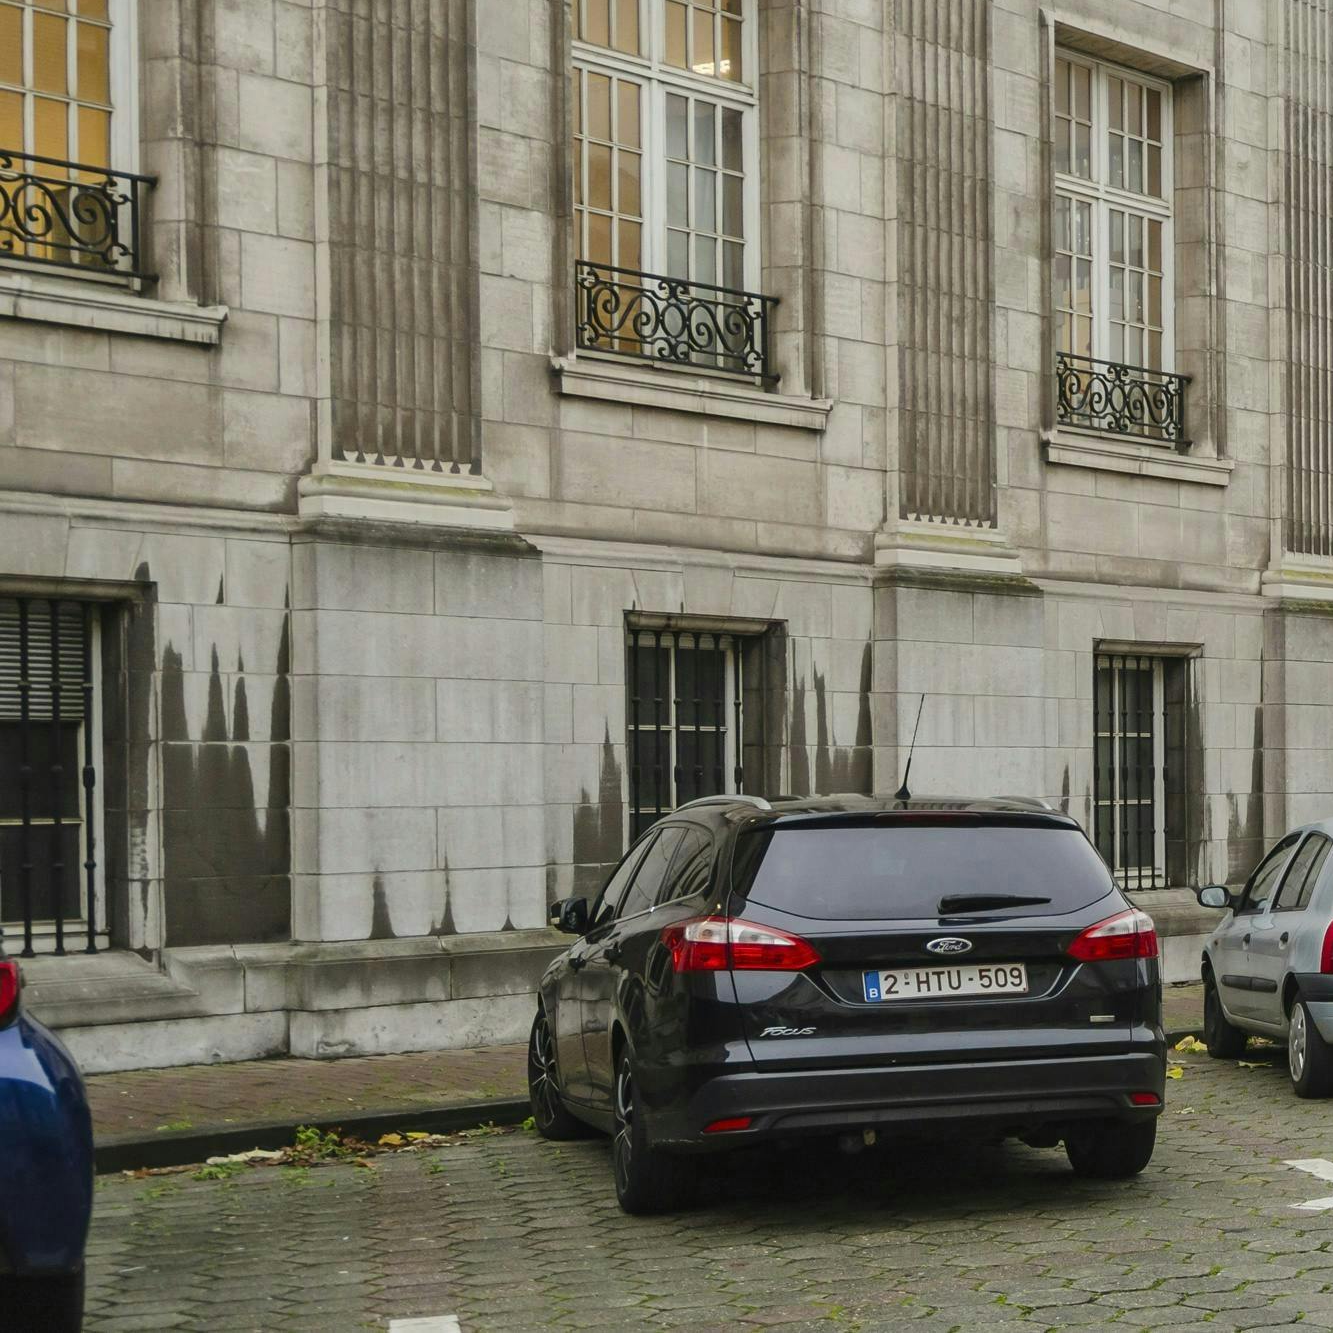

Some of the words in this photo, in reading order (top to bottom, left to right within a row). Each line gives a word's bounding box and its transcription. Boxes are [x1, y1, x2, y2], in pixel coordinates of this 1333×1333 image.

[935, 940, 963, 953] Ford
[869, 988, 879, 998] B
[884, 967, 1023, 995] 2-HTU-509
